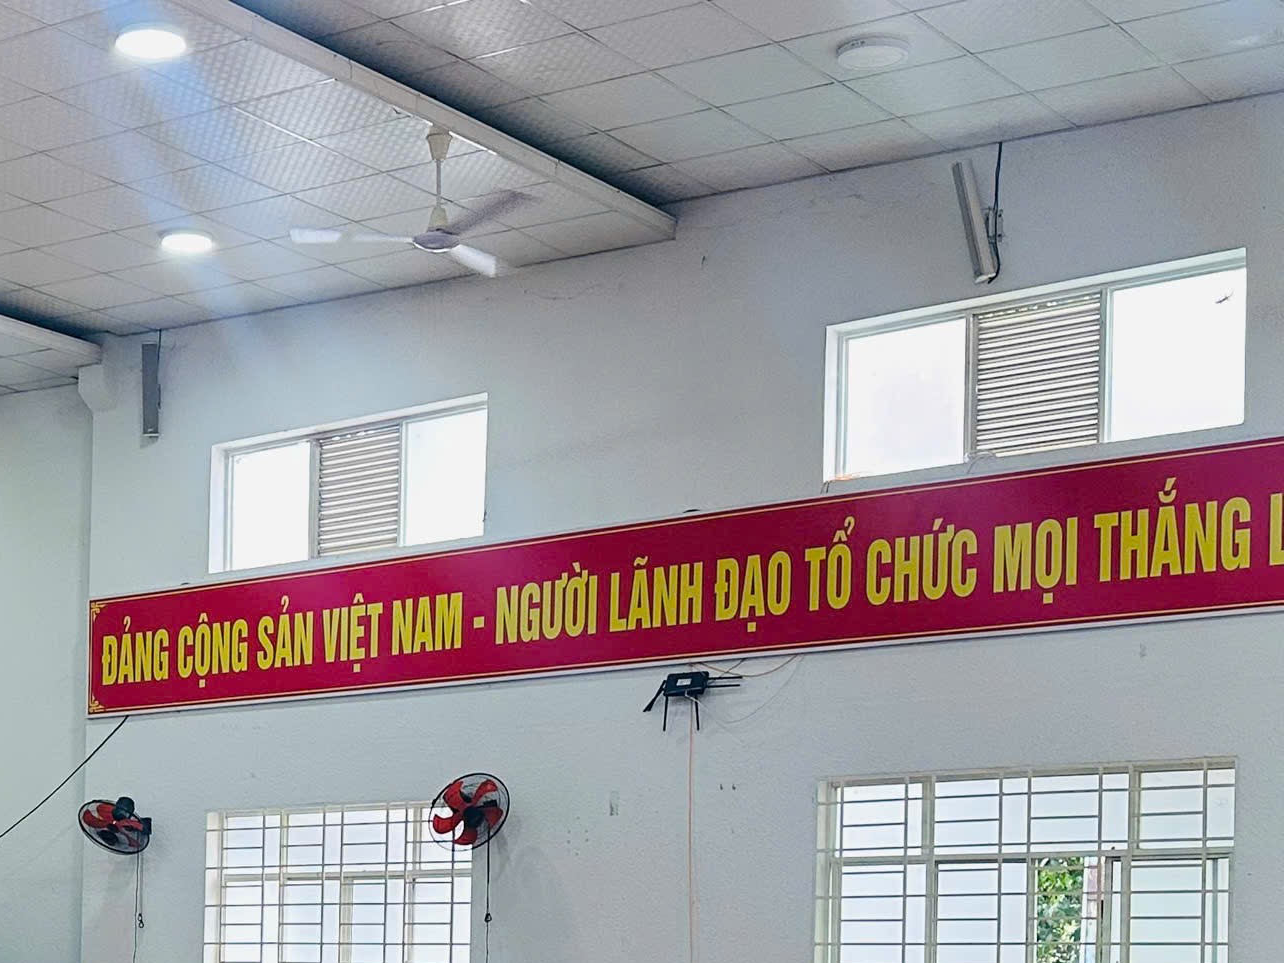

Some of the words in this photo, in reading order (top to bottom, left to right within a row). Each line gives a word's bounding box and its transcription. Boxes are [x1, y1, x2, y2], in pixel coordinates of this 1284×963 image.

[101, 615, 170, 686] ĐẢNG
[177, 612, 249, 688] CỘNG
[256, 595, 314, 671] SẢN
[322, 592, 384, 673] VIỆT
[391, 591, 463, 656] NAM
[473, 615, 485, 629] -
[494, 562, 598, 645] NGƯỜI
[609, 555, 704, 633] LÃNH
[714, 550, 792, 633] ĐẠO
[804, 516, 855, 611] TỔ
[867, 517, 978, 606] CHỨC
[993, 516, 1078, 605] MỌI
[1093, 477, 1251, 583] THẮNG
